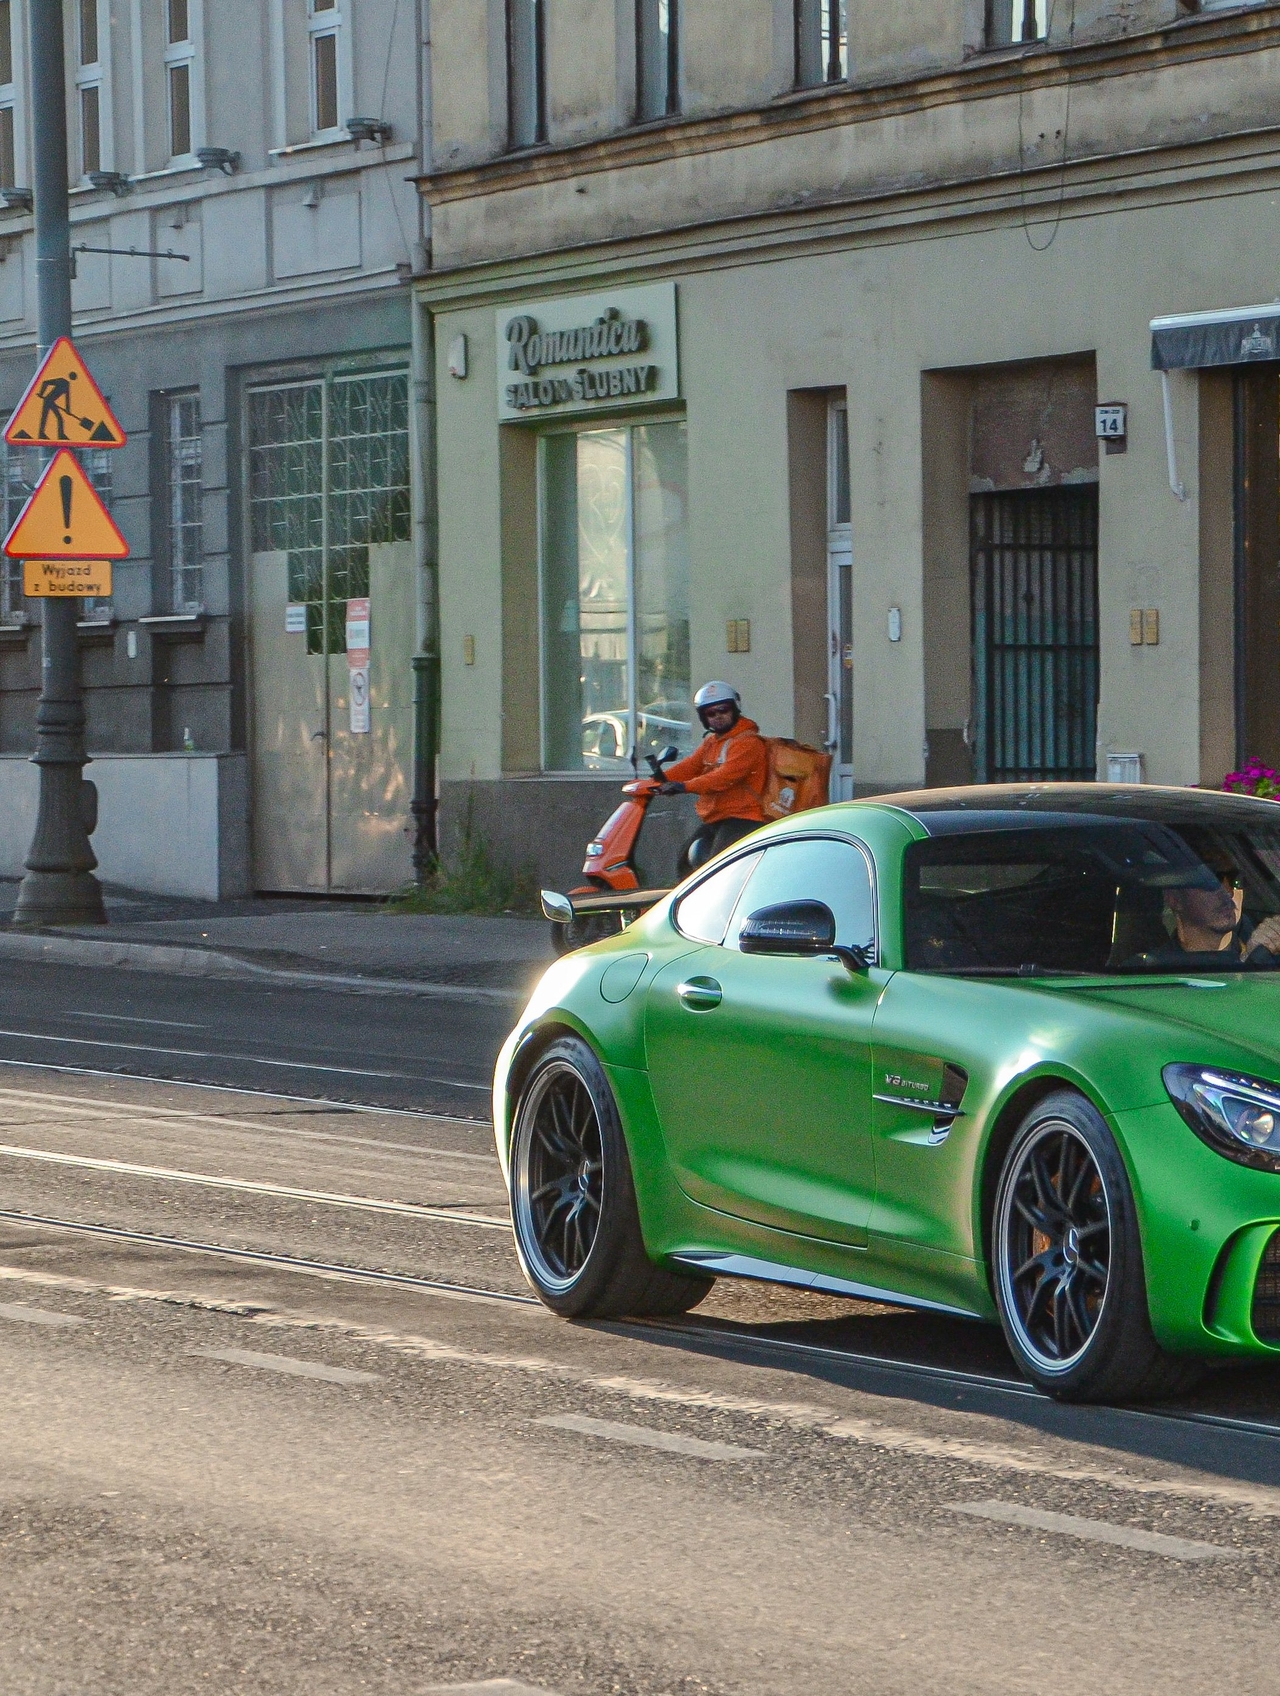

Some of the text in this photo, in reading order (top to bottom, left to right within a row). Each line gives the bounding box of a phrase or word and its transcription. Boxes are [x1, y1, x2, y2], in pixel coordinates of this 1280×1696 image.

[505, 307, 646, 375] Romantica
[506, 366, 656, 408] SALON ŚLUBNY
[1100, 418, 1118, 433] 14
[42, 563, 91, 578] Wyjazd
[34, 581, 101, 596] z budowy
[885, 1073, 929, 1091] V8 BITURBO
